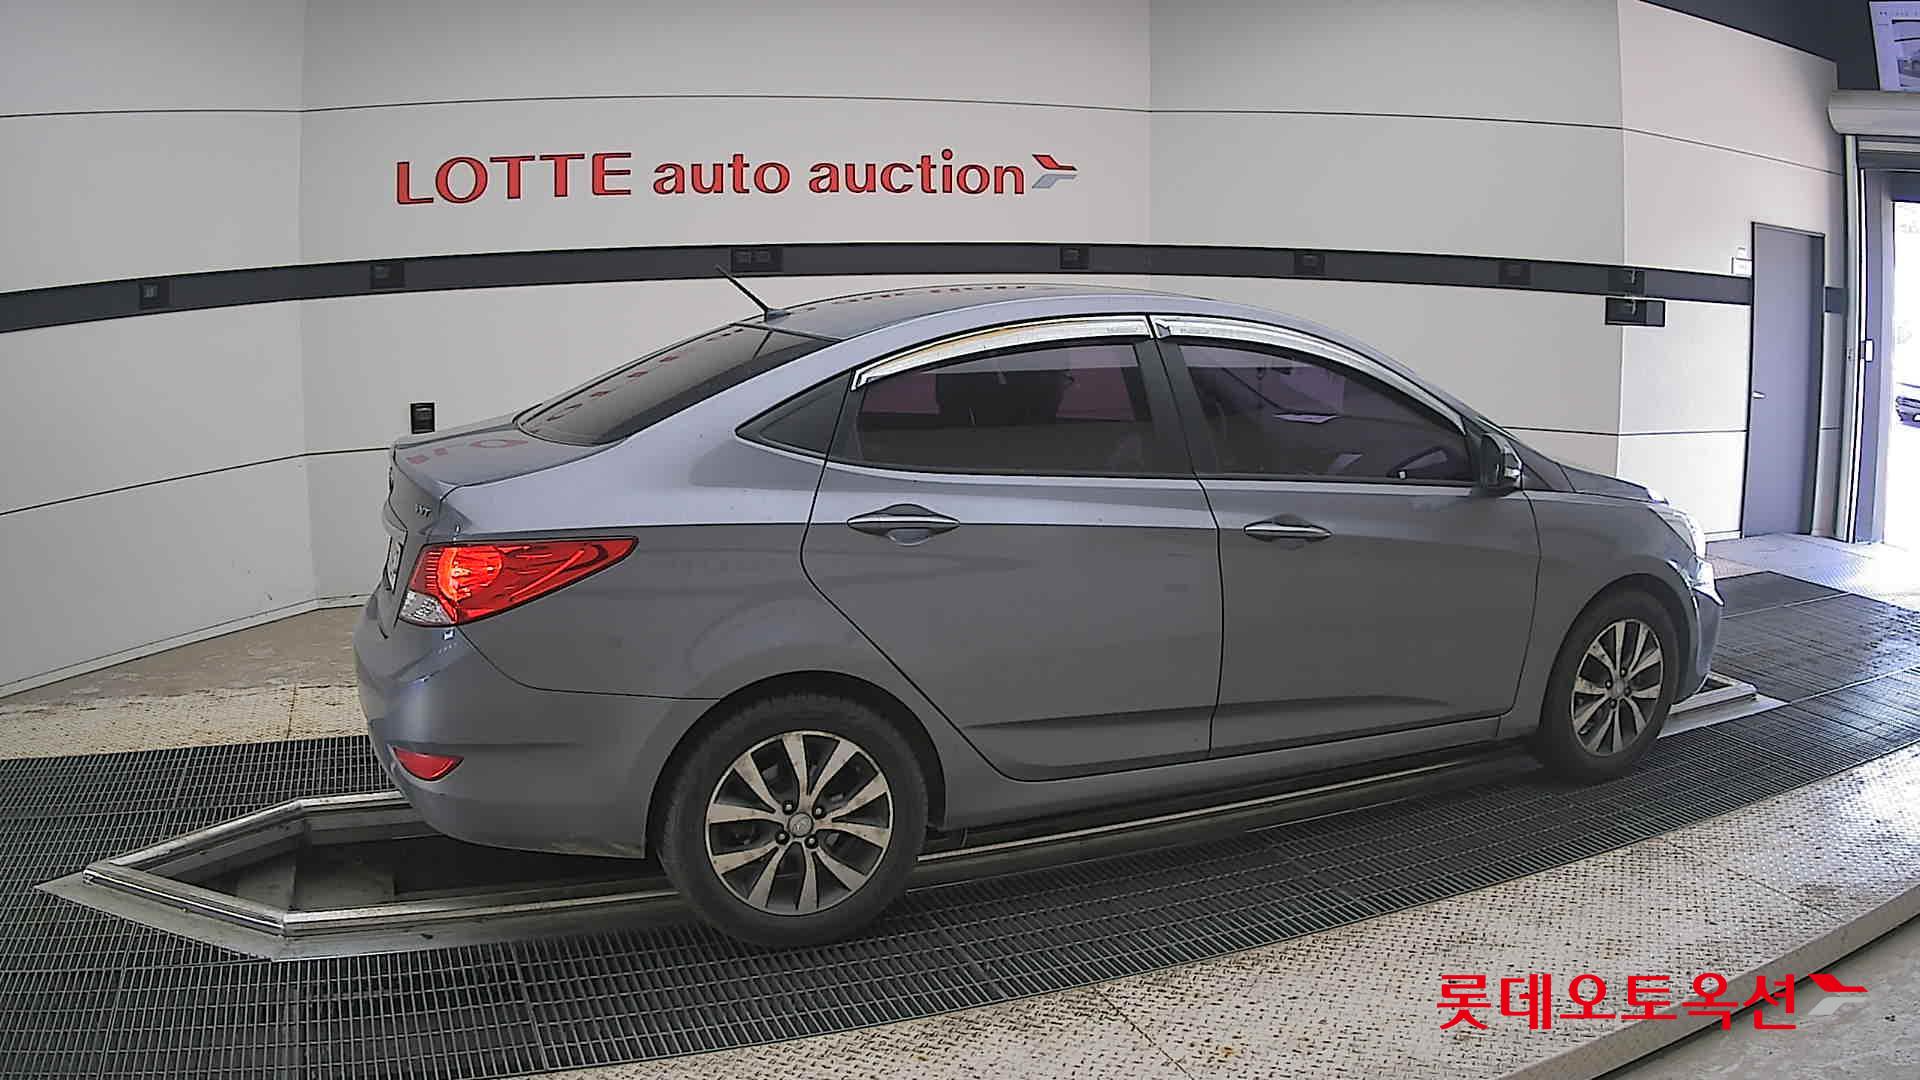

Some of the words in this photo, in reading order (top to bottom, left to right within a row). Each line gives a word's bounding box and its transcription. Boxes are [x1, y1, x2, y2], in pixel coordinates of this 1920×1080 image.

[395, 151, 632, 206] LOTTE
[652, 153, 791, 196] auto
[807, 147, 1026, 196] auction
